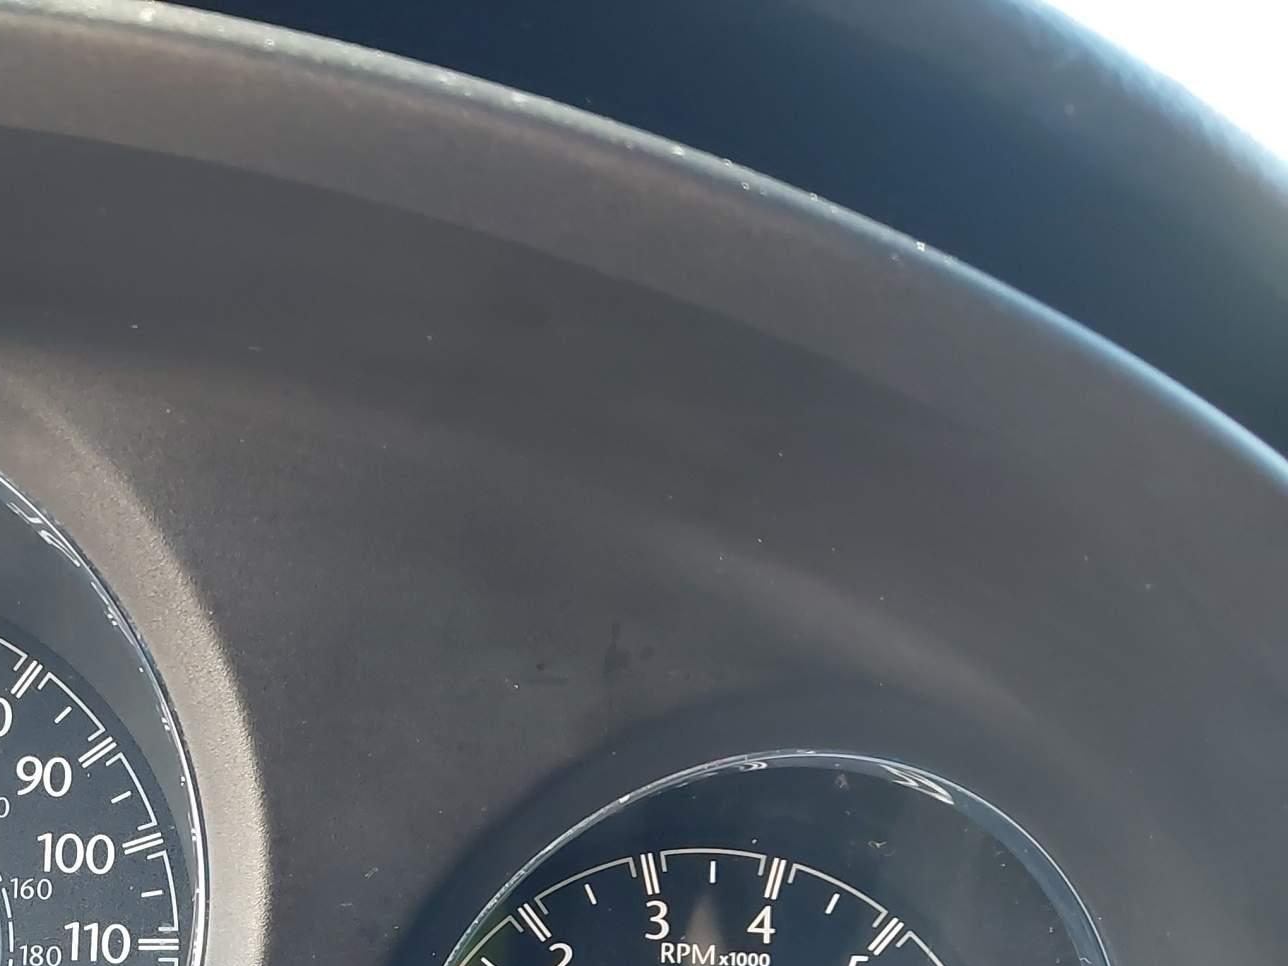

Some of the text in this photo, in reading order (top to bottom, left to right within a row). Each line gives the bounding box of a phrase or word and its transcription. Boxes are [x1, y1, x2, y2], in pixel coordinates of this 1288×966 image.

[16, 756, 73, 797] 90
[37, 833, 115, 874] 100
[11, 878, 53, 900] 160
[644, 902, 670, 940] 3
[747, 905, 776, 944] 4
[19, 945, 62, 966] 180
[65, 922, 130, 963] 110
